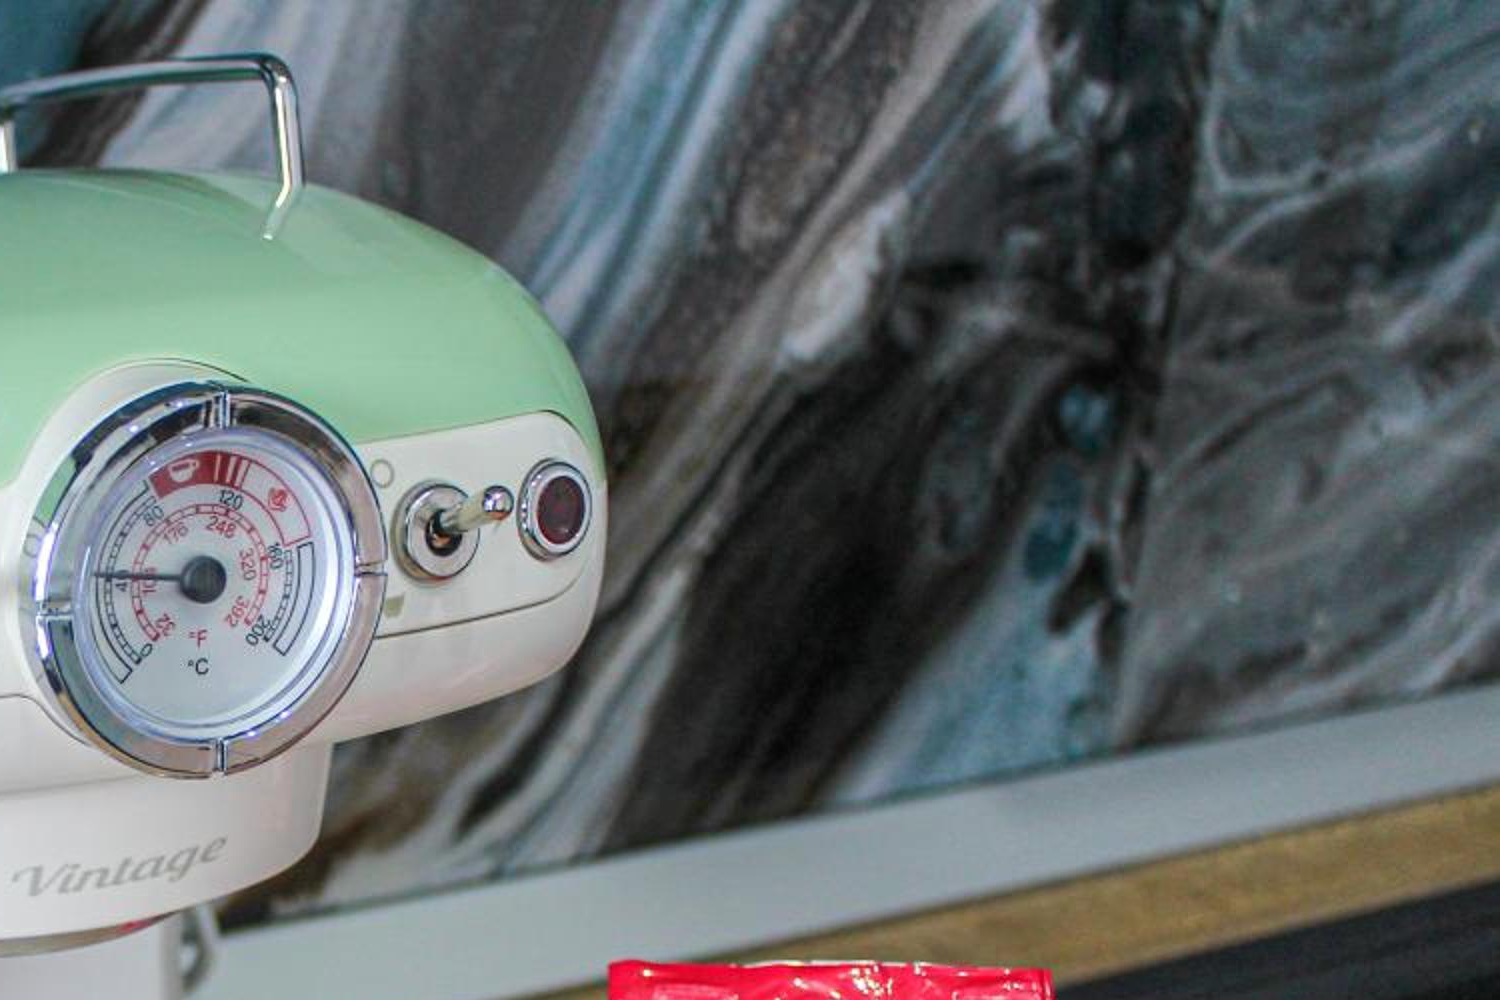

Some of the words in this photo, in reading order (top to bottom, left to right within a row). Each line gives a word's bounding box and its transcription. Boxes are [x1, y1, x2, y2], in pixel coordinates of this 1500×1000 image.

[217, 489, 244, 511] 120
[142, 504, 164, 528] 80
[205, 515, 237, 538] 248
[238, 547, 258, 582] 320
[267, 541, 284, 571] 160
[244, 614, 271, 647] 200
[11, 834, 229, 897] Vintage
